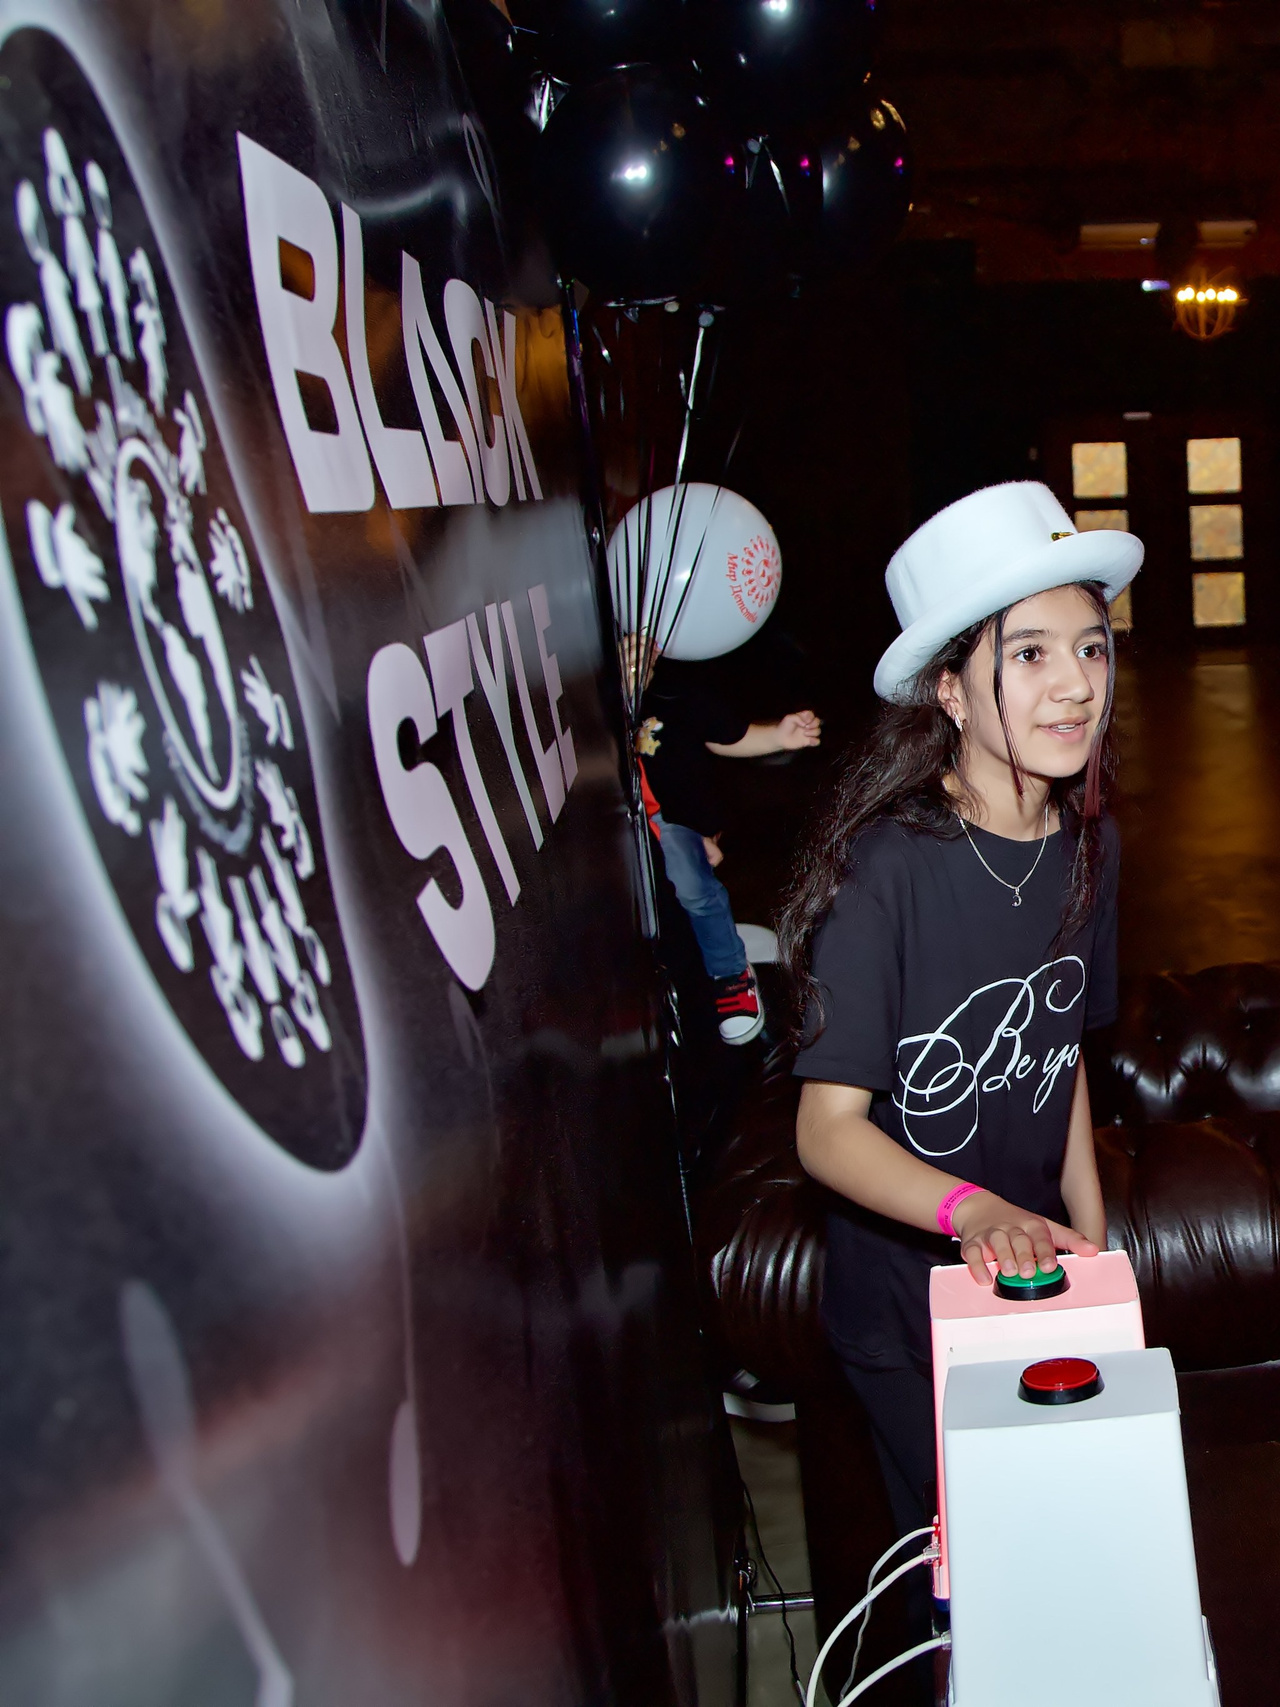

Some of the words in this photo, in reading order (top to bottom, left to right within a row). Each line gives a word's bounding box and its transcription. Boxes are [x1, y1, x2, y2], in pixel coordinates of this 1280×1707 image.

[237, 131, 544, 514] BLACK
[725, 551, 739, 582] Мир
[367, 583, 579, 991] STYLE
[892, 955, 1086, 1157] Be
